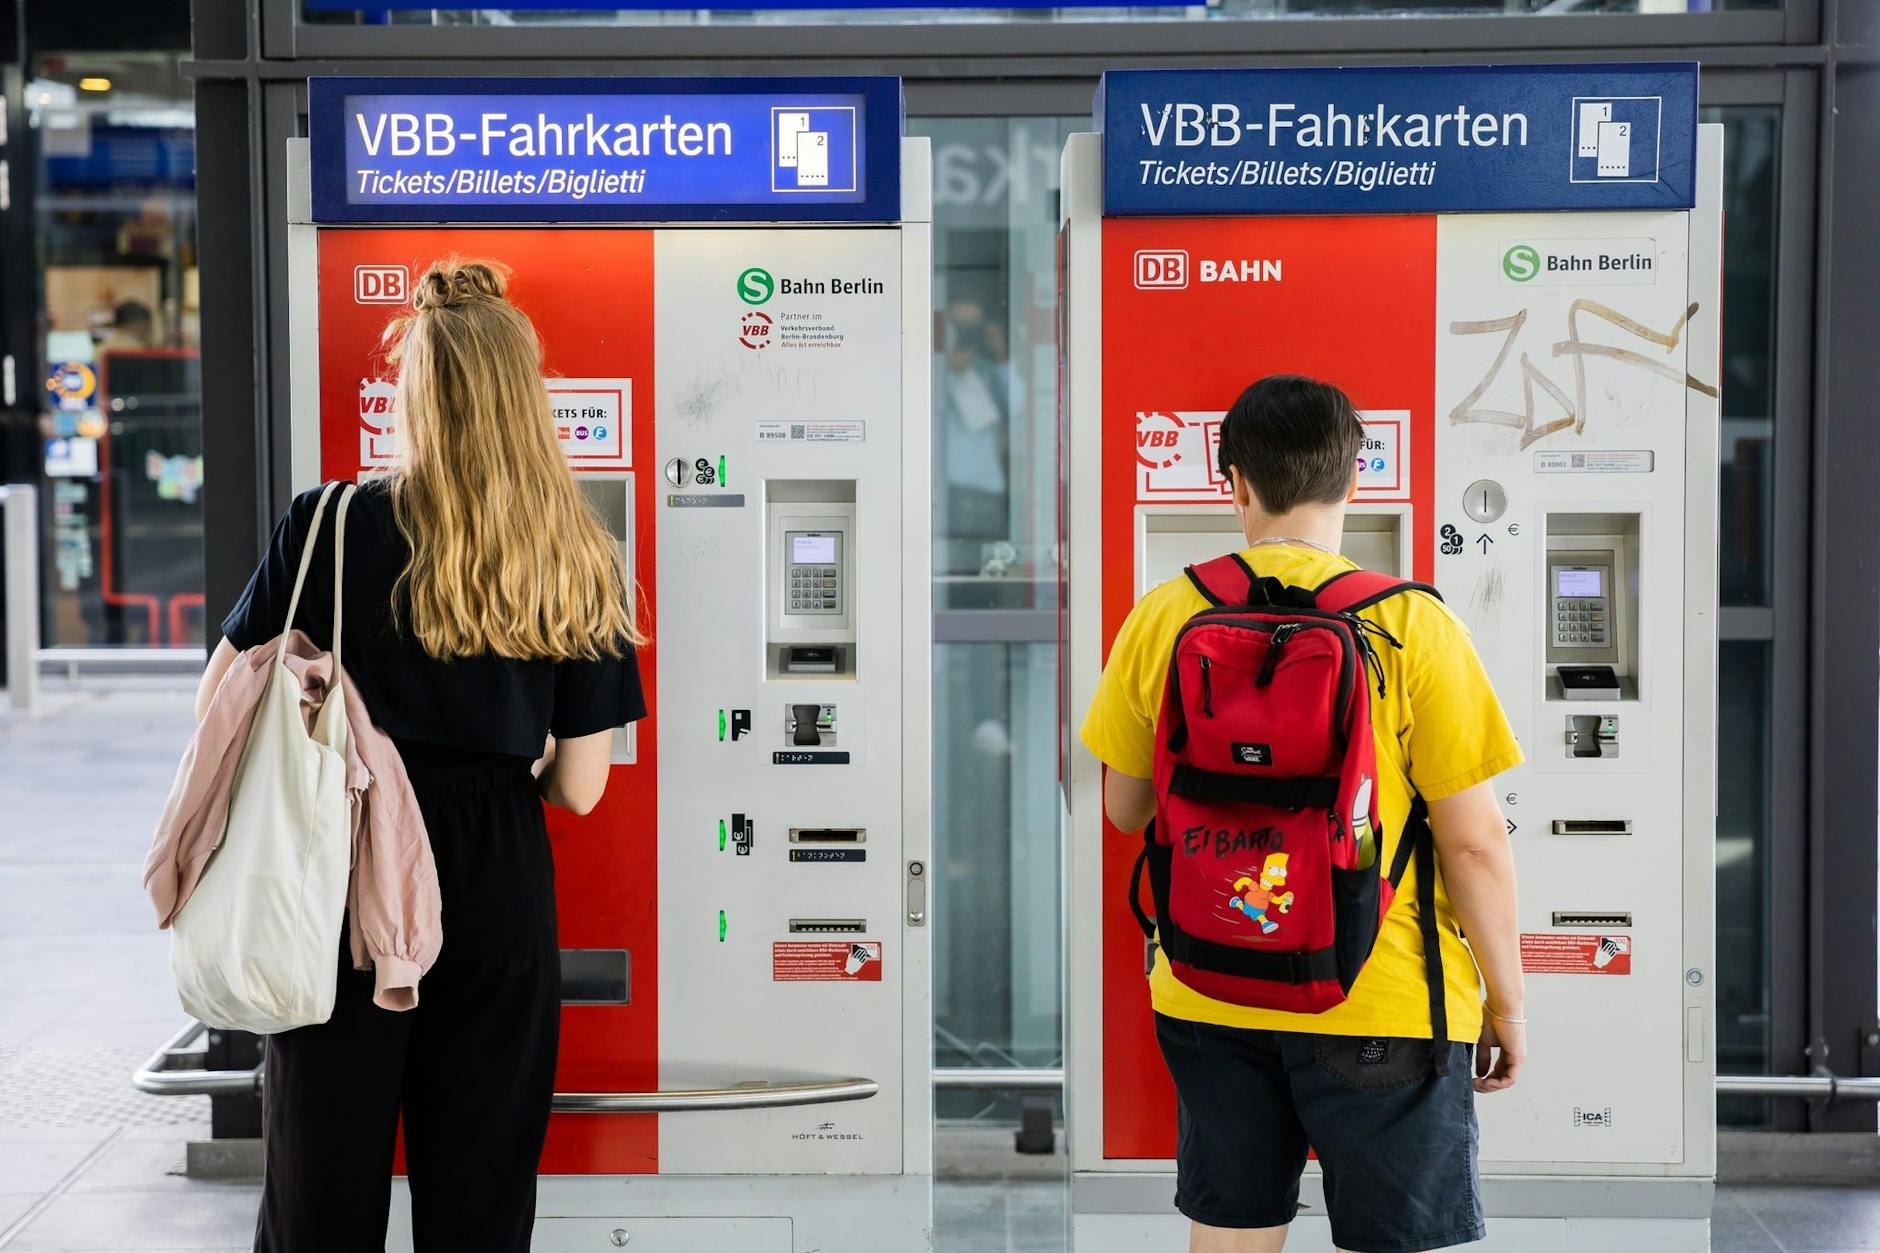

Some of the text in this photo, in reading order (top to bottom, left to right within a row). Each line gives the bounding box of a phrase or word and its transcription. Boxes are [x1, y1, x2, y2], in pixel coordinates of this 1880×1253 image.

[1602, 106, 1608, 117] 1
[800, 116, 806, 127] 1
[1140, 103, 1529, 147] VBB-Fahrkarten
[356, 113, 732, 157] VBB-Fahrkarten
[1619, 126, 1627, 136] 2
[817, 135, 825, 146] 2
[357, 168, 646, 200] Tickets/Billets/Biglietti
[1139, 159, 1437, 192] Tickets/Billets/Biglietti
[1142, 257, 1282, 282] DB BAHN
[1509, 248, 1652, 280] S Bahn Berlin
[362, 272, 402, 297] DB
[743, 270, 884, 303] S Bahn Berlin
[780, 312, 822, 321] Partner im
[742, 325, 769, 336] VBB
[582, 406, 608, 418] FÜR:
[1137, 430, 1179, 448] VBB
[1582, 1112, 1603, 1121] ICA
